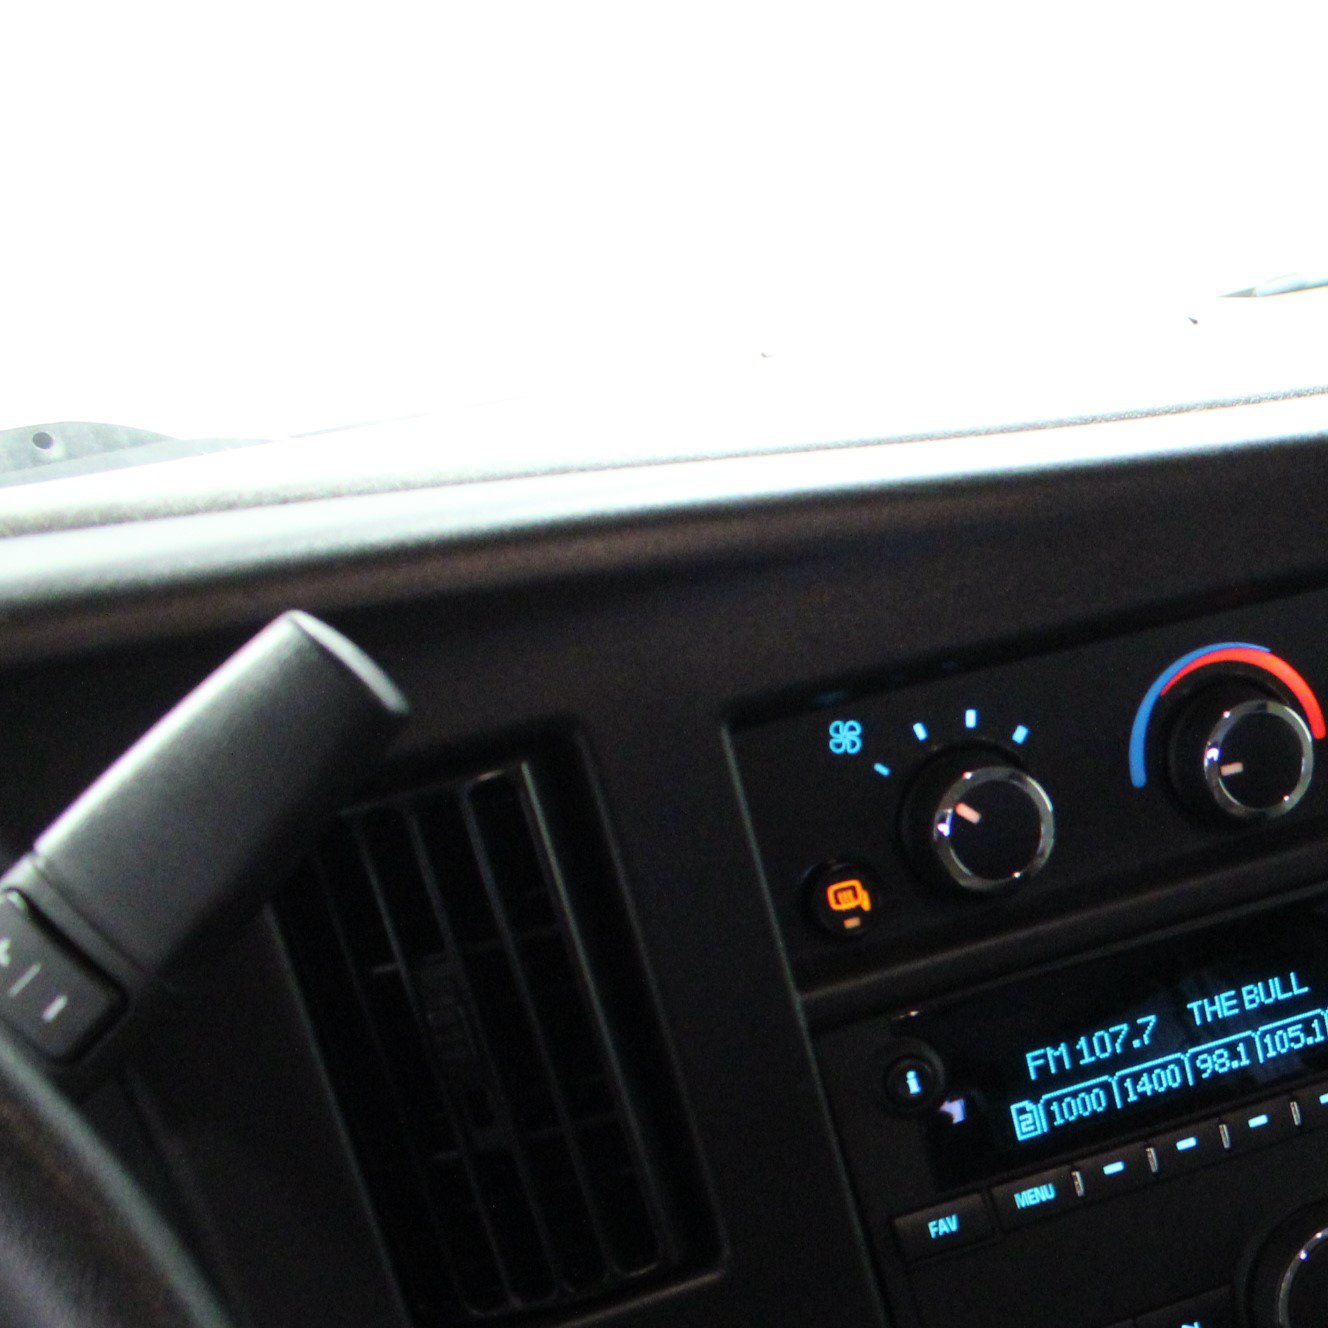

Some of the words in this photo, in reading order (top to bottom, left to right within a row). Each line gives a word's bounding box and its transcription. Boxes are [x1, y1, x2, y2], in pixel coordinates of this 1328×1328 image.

[1025, 1041, 1072, 1080] FM
[1076, 1015, 1158, 1065] 107.7
[1187, 991, 1239, 1026] THE
[1241, 972, 1309, 1011] BULL
[1050, 1088, 1108, 1127] 1000
[1123, 1064, 1182, 1101] 1400
[1195, 1042, 1251, 1078] 98.1
[1263, 1022, 1326, 1058] 105.1
[928, 1214, 959, 1239] FAV
[1014, 1183, 1056, 1210] MENU
